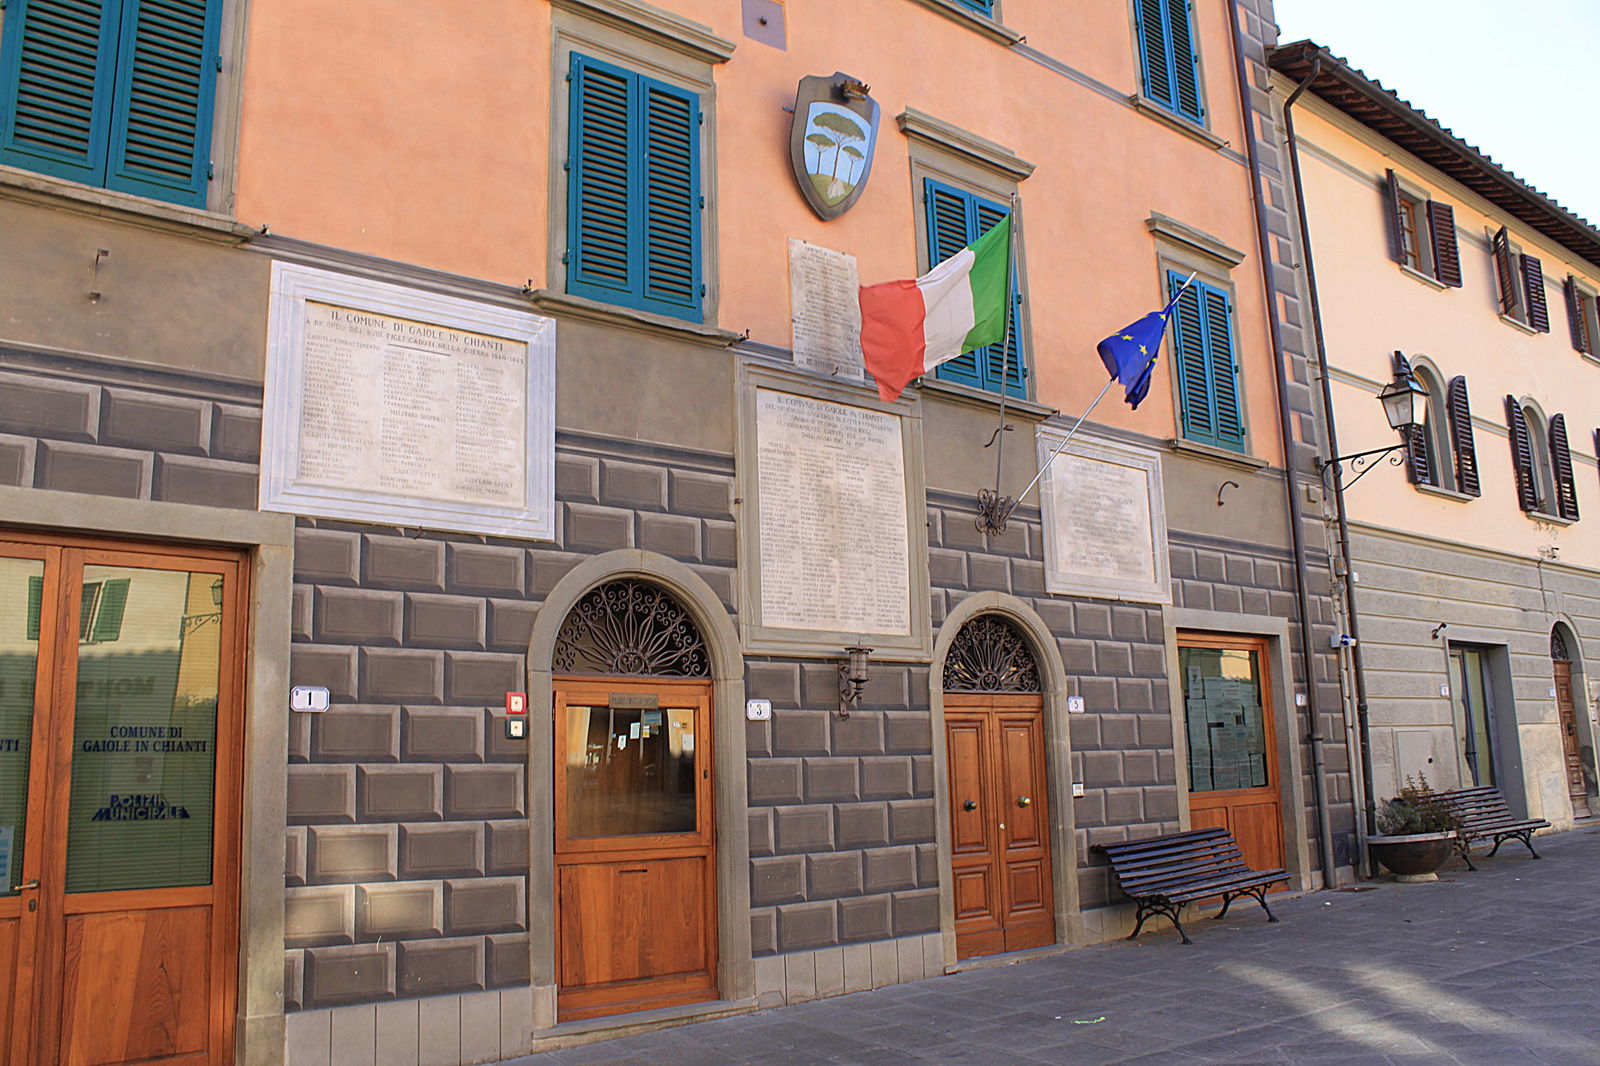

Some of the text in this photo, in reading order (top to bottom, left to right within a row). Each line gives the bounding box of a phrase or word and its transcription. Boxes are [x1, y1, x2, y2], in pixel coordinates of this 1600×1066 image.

[331, 310, 503, 352] IL COMUNE DI GAIOLE IN CHIANTI
[314, 320, 345, 331] RICORDO
[386, 333, 405, 343] FIGLI
[408, 337, 435, 348] CADUTI
[437, 343, 461, 353] NELLA
[463, 348, 489, 359] GUERRA
[307, 691, 313, 706] 1
[756, 703, 763, 717] 3
[110, 725, 182, 739] COMUNE DI
[83, 740, 207, 753] GAIOLE IN CHIANTI
[110, 792, 170, 808] POLIZIA
[92, 805, 190, 821] MUNICIPALE
